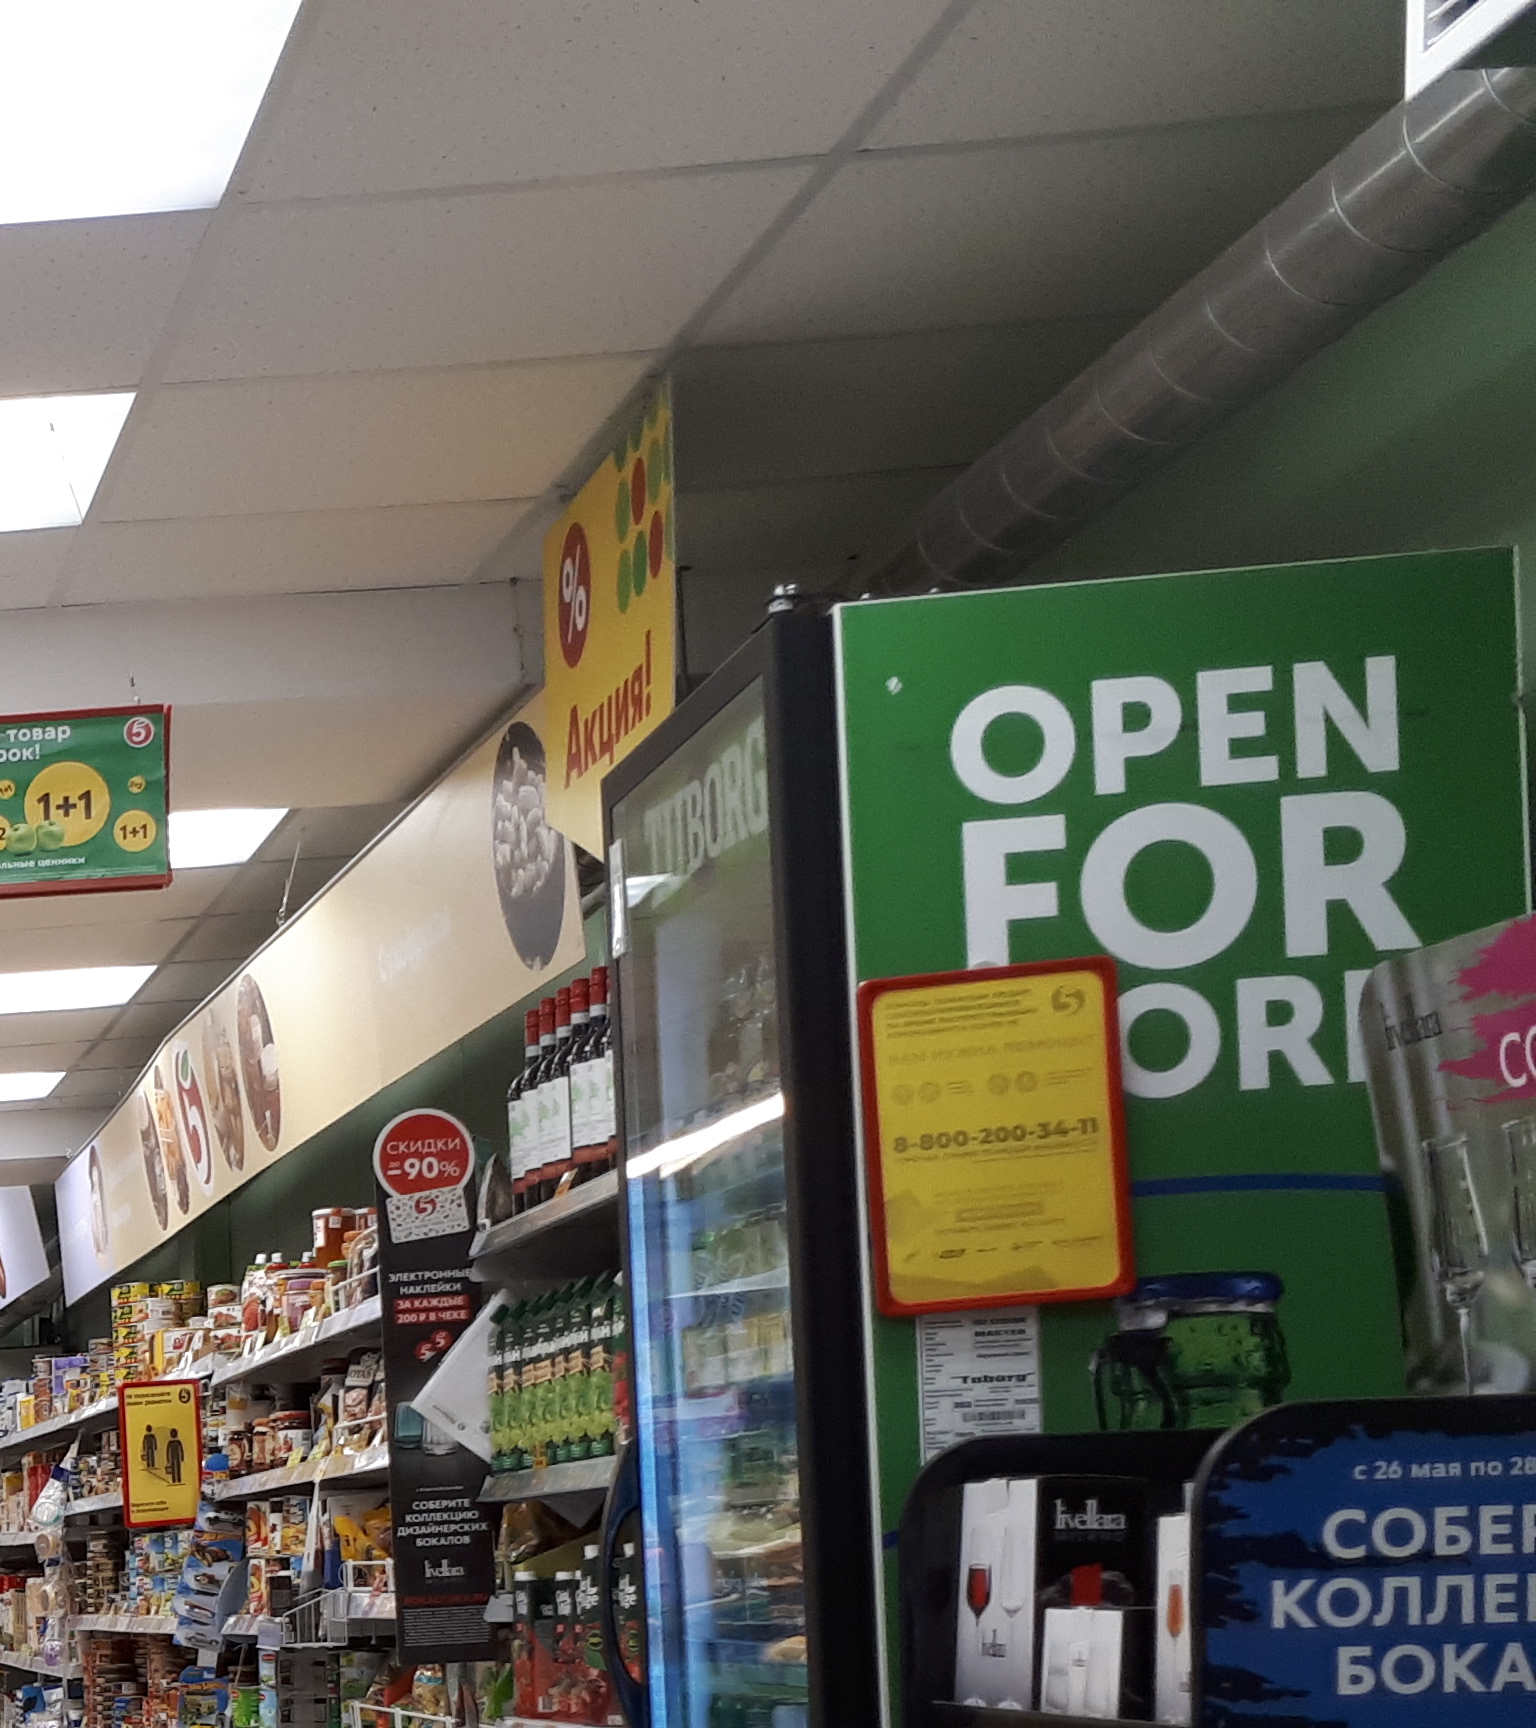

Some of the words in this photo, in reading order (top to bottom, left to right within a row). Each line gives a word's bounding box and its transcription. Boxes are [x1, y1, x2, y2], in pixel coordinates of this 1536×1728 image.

[563, 629, 653, 788] Акция!
[7, 725, 71, 747] товар
[949, 656, 1400, 803] OPEN
[36, 789, 93, 821] 1+1
[119, 823, 148, 840] 1+1
[961, 790, 1422, 968] FOR
[386, 1137, 461, 1155] СКИДКИ
[399, 1281, 462, 1296] НАКЛЕЙКИ
[1353, 1466, 1367, 1480] с
[1374, 1460, 1403, 1480] 26
[1411, 1461, 1461, 1479] мая
[1470, 1460, 1502, 1477] по
[411, 1498, 471, 1512] СОБЕРИТЕ
[404, 1510, 479, 1523] КОЛЛЕКЦИЮ
[396, 1521, 489, 1538] ДИЗАЙНЕРСКИХ
[415, 1535, 471, 1548] БОКАЛОВ
